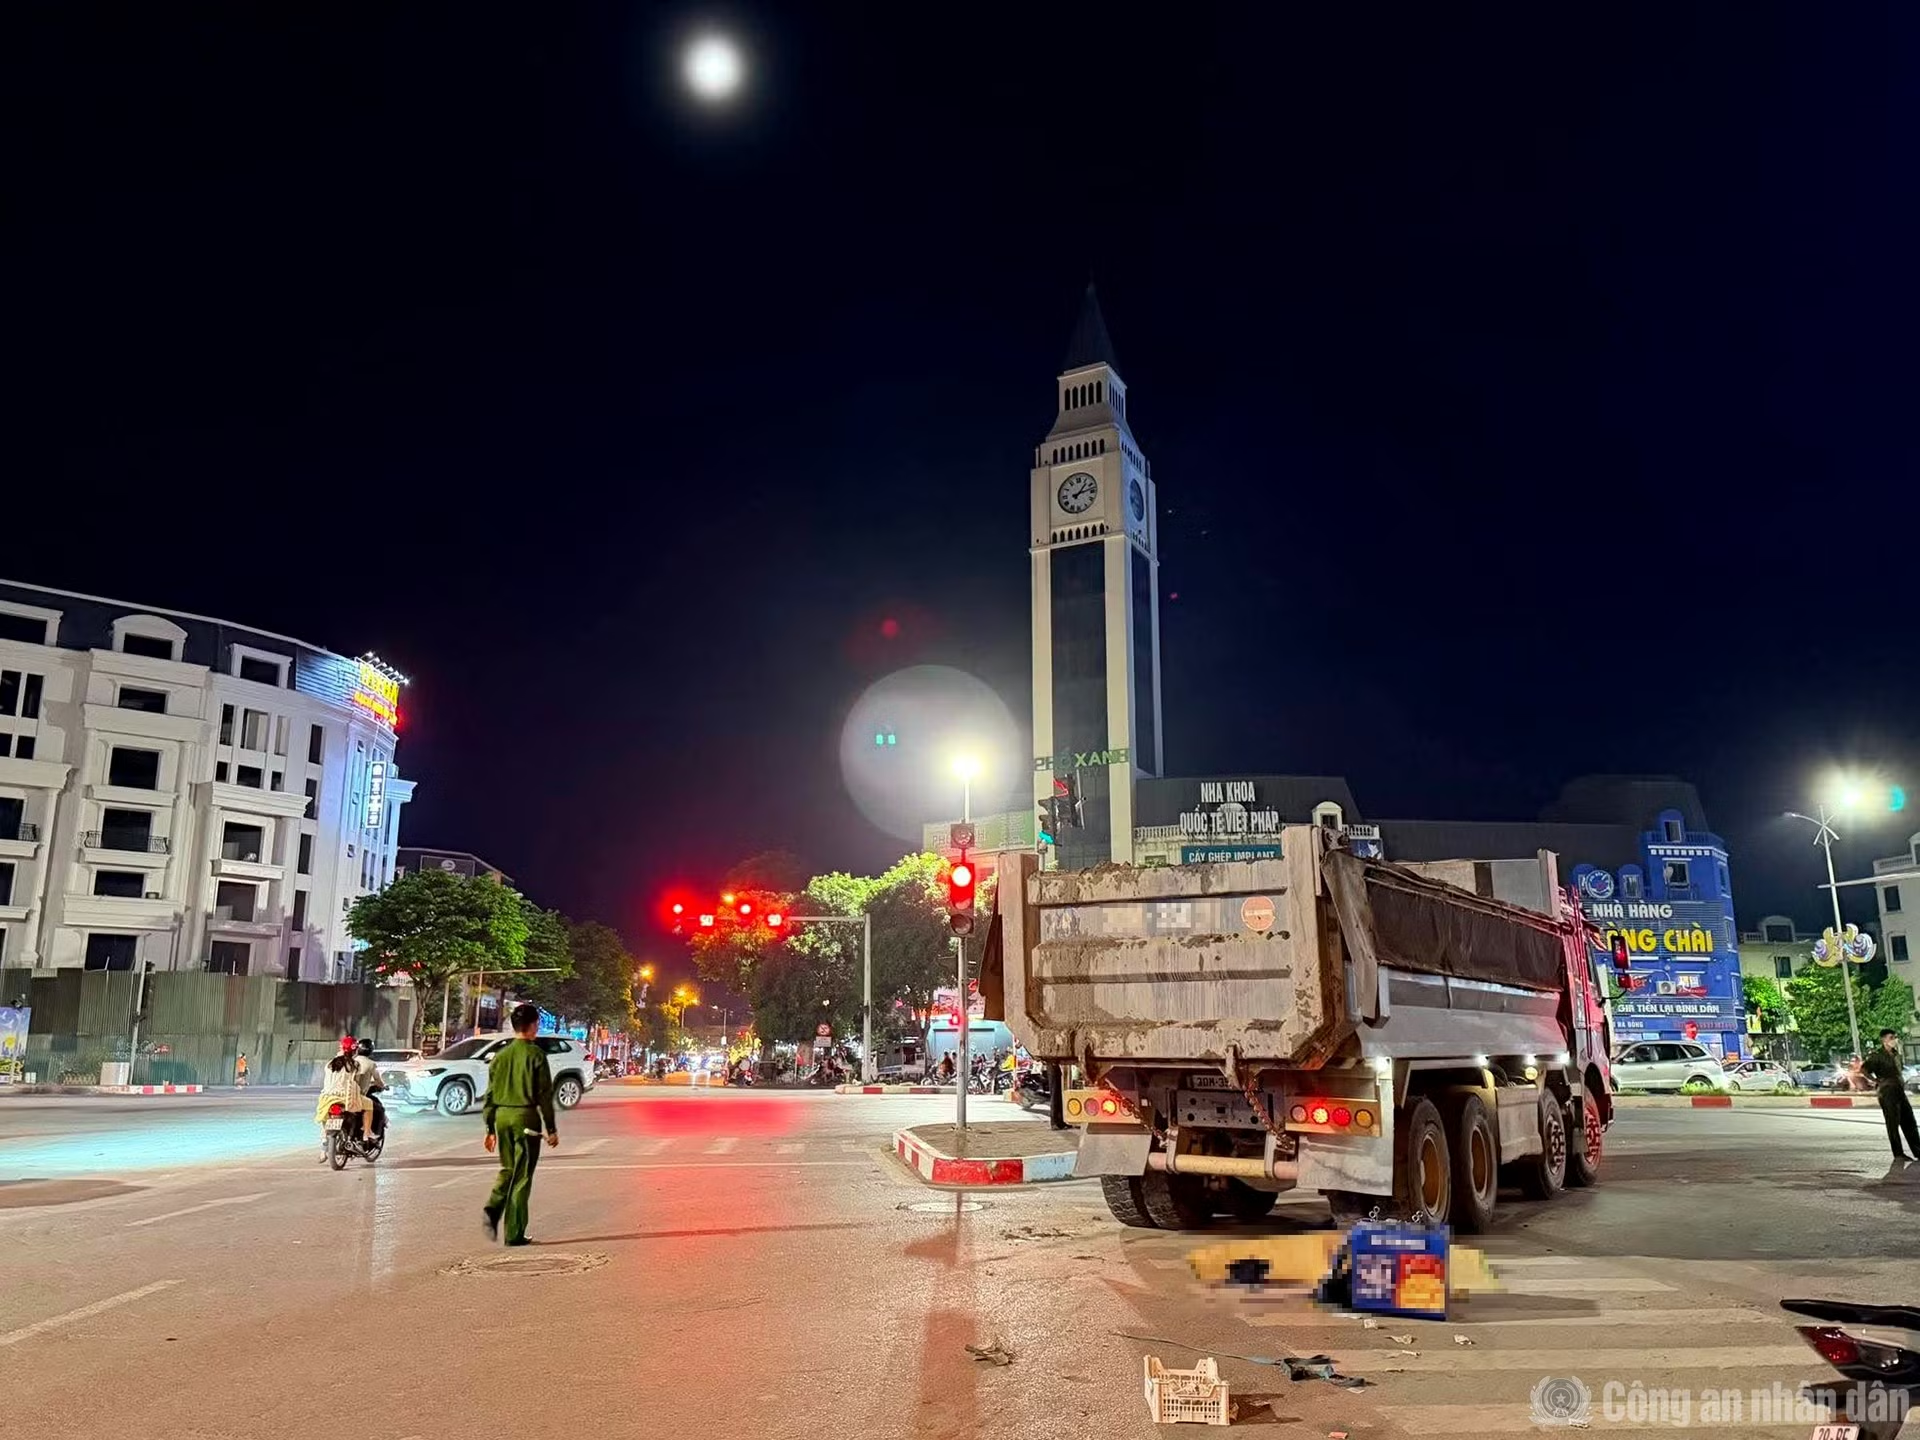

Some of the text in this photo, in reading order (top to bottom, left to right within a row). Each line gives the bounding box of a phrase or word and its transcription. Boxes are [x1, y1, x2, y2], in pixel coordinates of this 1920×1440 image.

[1201, 781, 1256, 803] NHA KHOA
[1180, 804, 1208, 834] QUỐC
[1250, 805, 1279, 833] PHÁP
[1628, 900, 1673, 919] HÀNG
[1663, 922, 1714, 952] CHÀI
